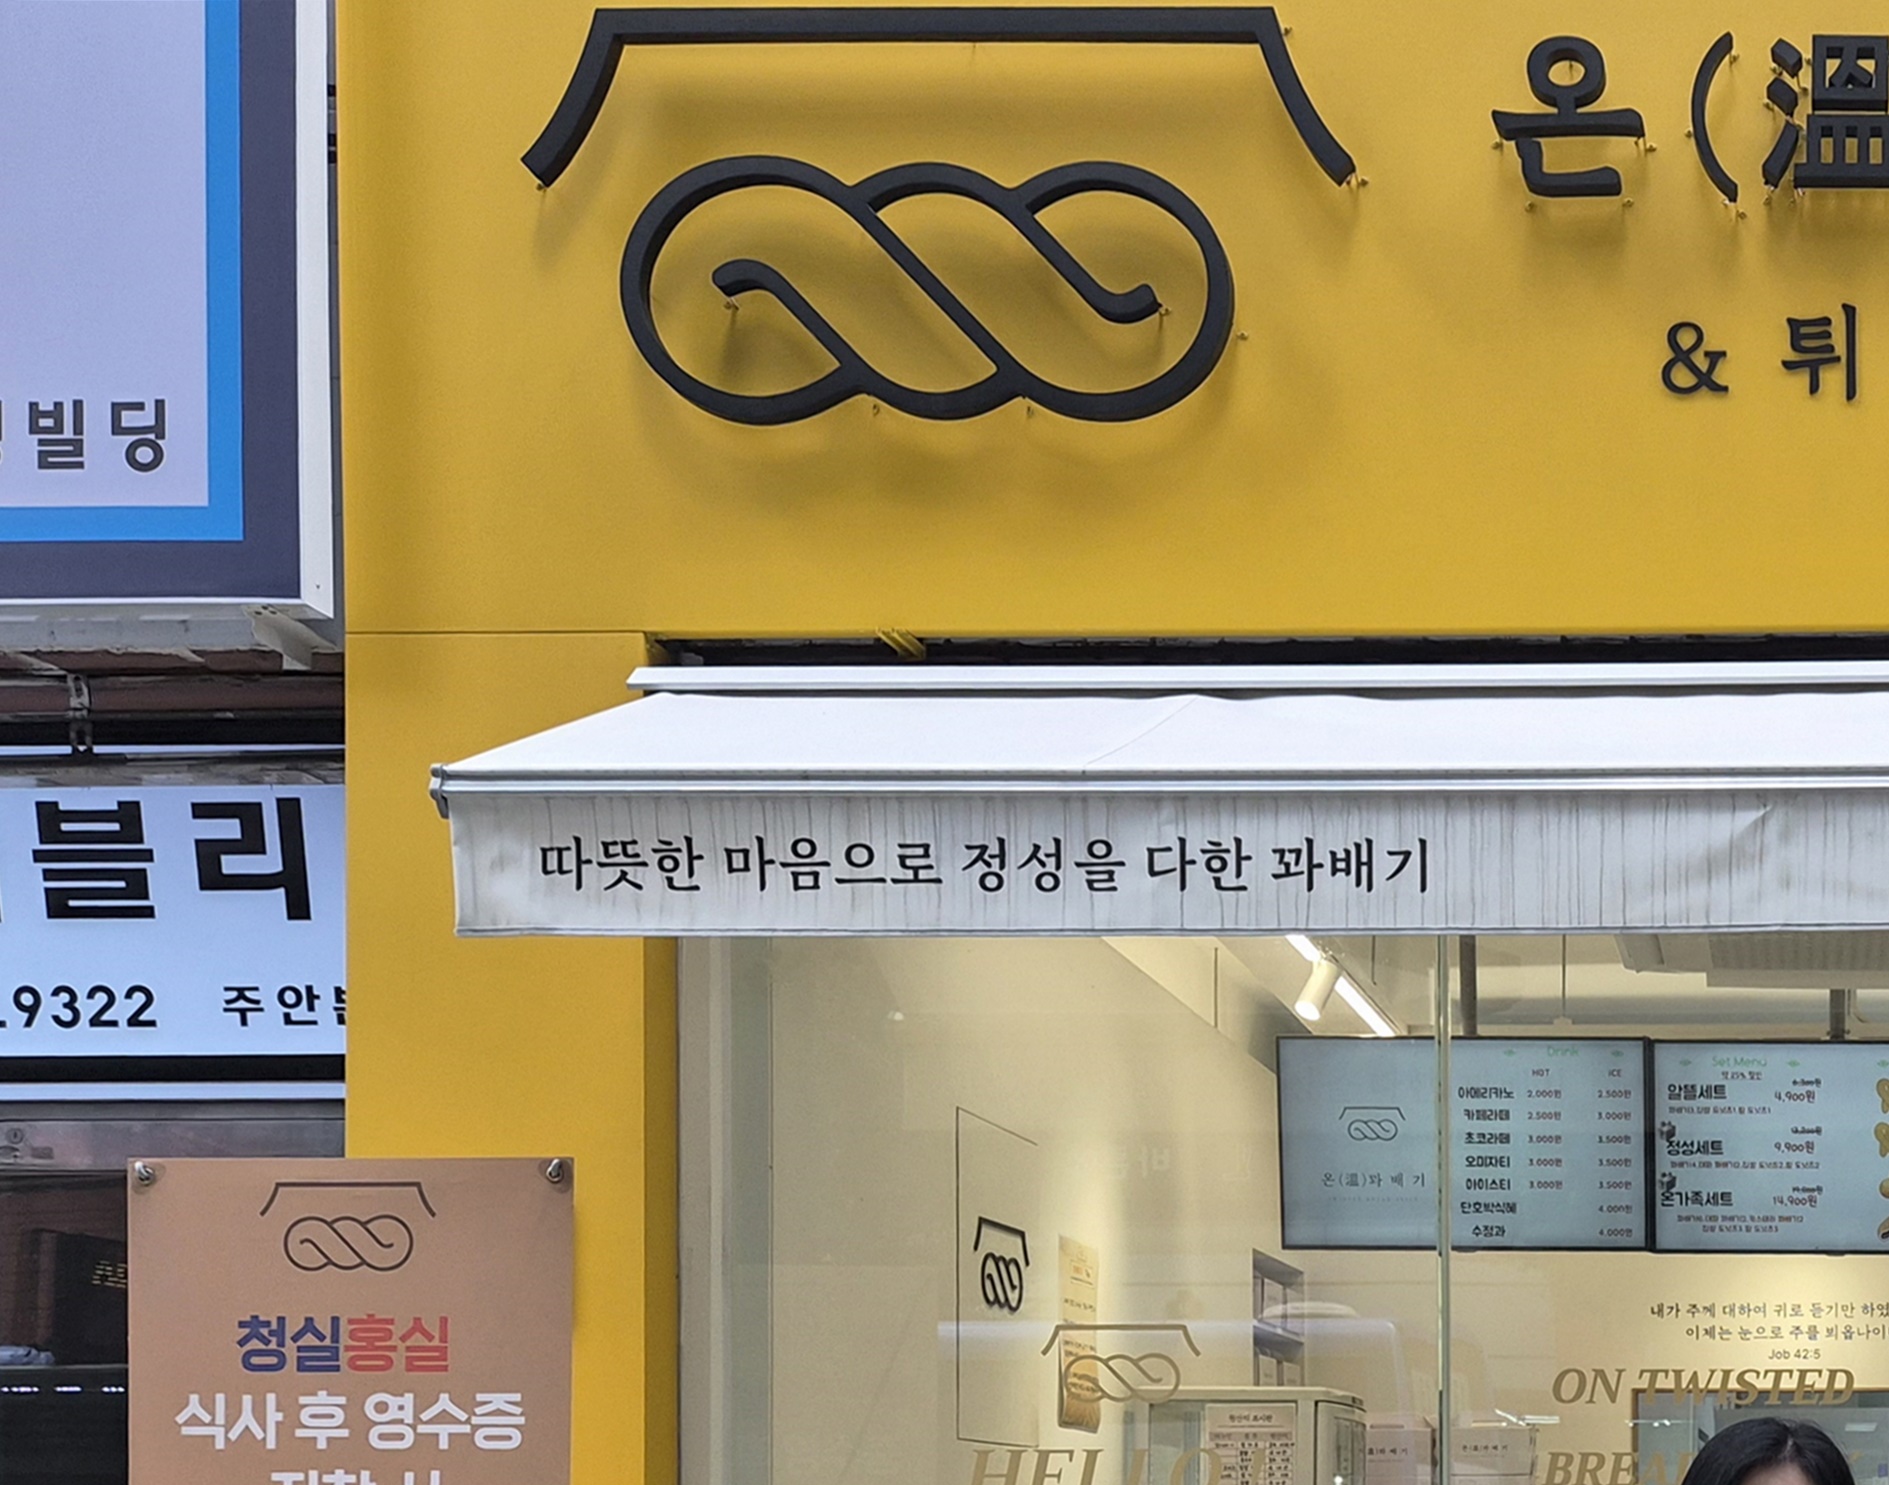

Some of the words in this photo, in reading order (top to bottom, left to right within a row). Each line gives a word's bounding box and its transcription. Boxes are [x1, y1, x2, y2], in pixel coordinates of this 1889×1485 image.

[0, 398, 166, 472] 빌딩
[0, 796, 312, 921] 블리
[539, 837, 704, 893] 따뜻한
[723, 836, 944, 893] 마음으로
[961, 837, 1127, 893] 정성을
[1145, 838, 1253, 893] 다한
[1270, 838, 1432, 893] 꽈배기
[0, 985, 157, 1028] 9322
[1736, 1056, 1767, 1067] Menu
[1667, 1083, 1728, 1101] 알뜰세트
[1665, 1139, 1724, 1156] 정성세트
[1465, 1155, 1511, 1168] 오미자티
[1465, 1178, 1511, 1191] 아이스티
[1660, 1190, 1734, 1207] 온가족세트
[1471, 1225, 1506, 1238] 수정과
[1650, 1302, 1681, 1318] 내가
[1686, 1302, 1716, 1318] 주께
[1721, 1302, 1768, 1318] 대하여
[1773, 1302, 1805, 1318] 귀로
[1810, 1302, 1856, 1319] 듣기만
[1686, 1324, 1733, 1341] 이제는
[1737, 1324, 1784, 1341] 눈으로
[1789, 1324, 1820, 1341] 주를
[236, 1313, 450, 1373] 청실홍실
[1768, 1348, 1790, 1361] Job
[1793, 1348, 1821, 1360] 42:5
[1551, 1368, 1626, 1405] ON
[1637, 1367, 1856, 1407] TWISTED
[174, 1392, 284, 1450] 식사
[294, 1390, 350, 1450] 후
[363, 1392, 526, 1450] 영수증
